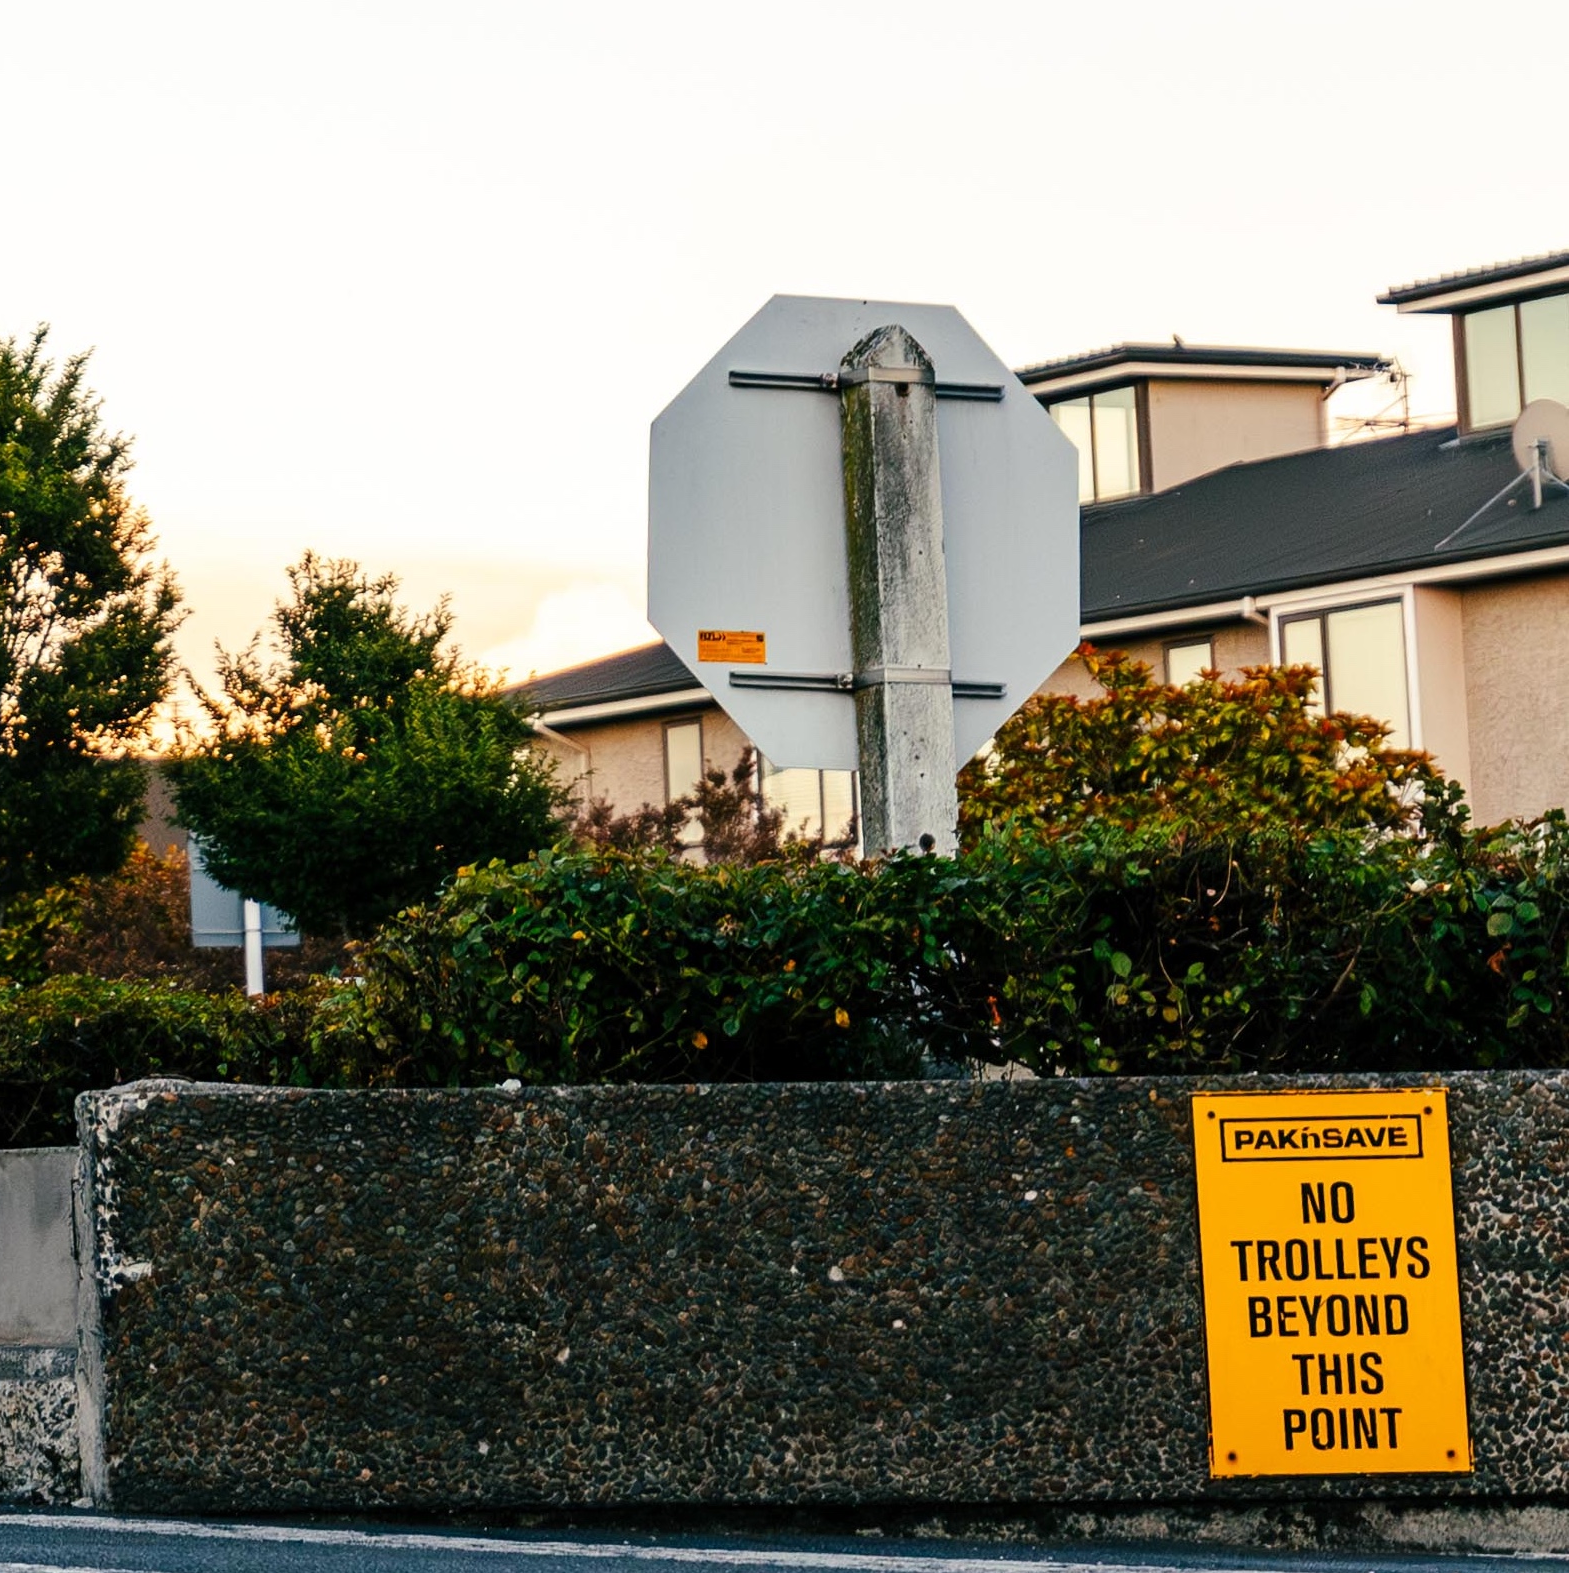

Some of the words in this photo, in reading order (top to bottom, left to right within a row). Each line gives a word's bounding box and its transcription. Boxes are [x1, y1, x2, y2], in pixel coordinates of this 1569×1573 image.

[1301, 1181, 1356, 1224] NO
[1230, 1236, 1431, 1282] TROLLEYS
[1248, 1294, 1410, 1338] BEYOND
[1292, 1352, 1384, 1395] THIS
[1283, 1407, 1403, 1451] POINT
